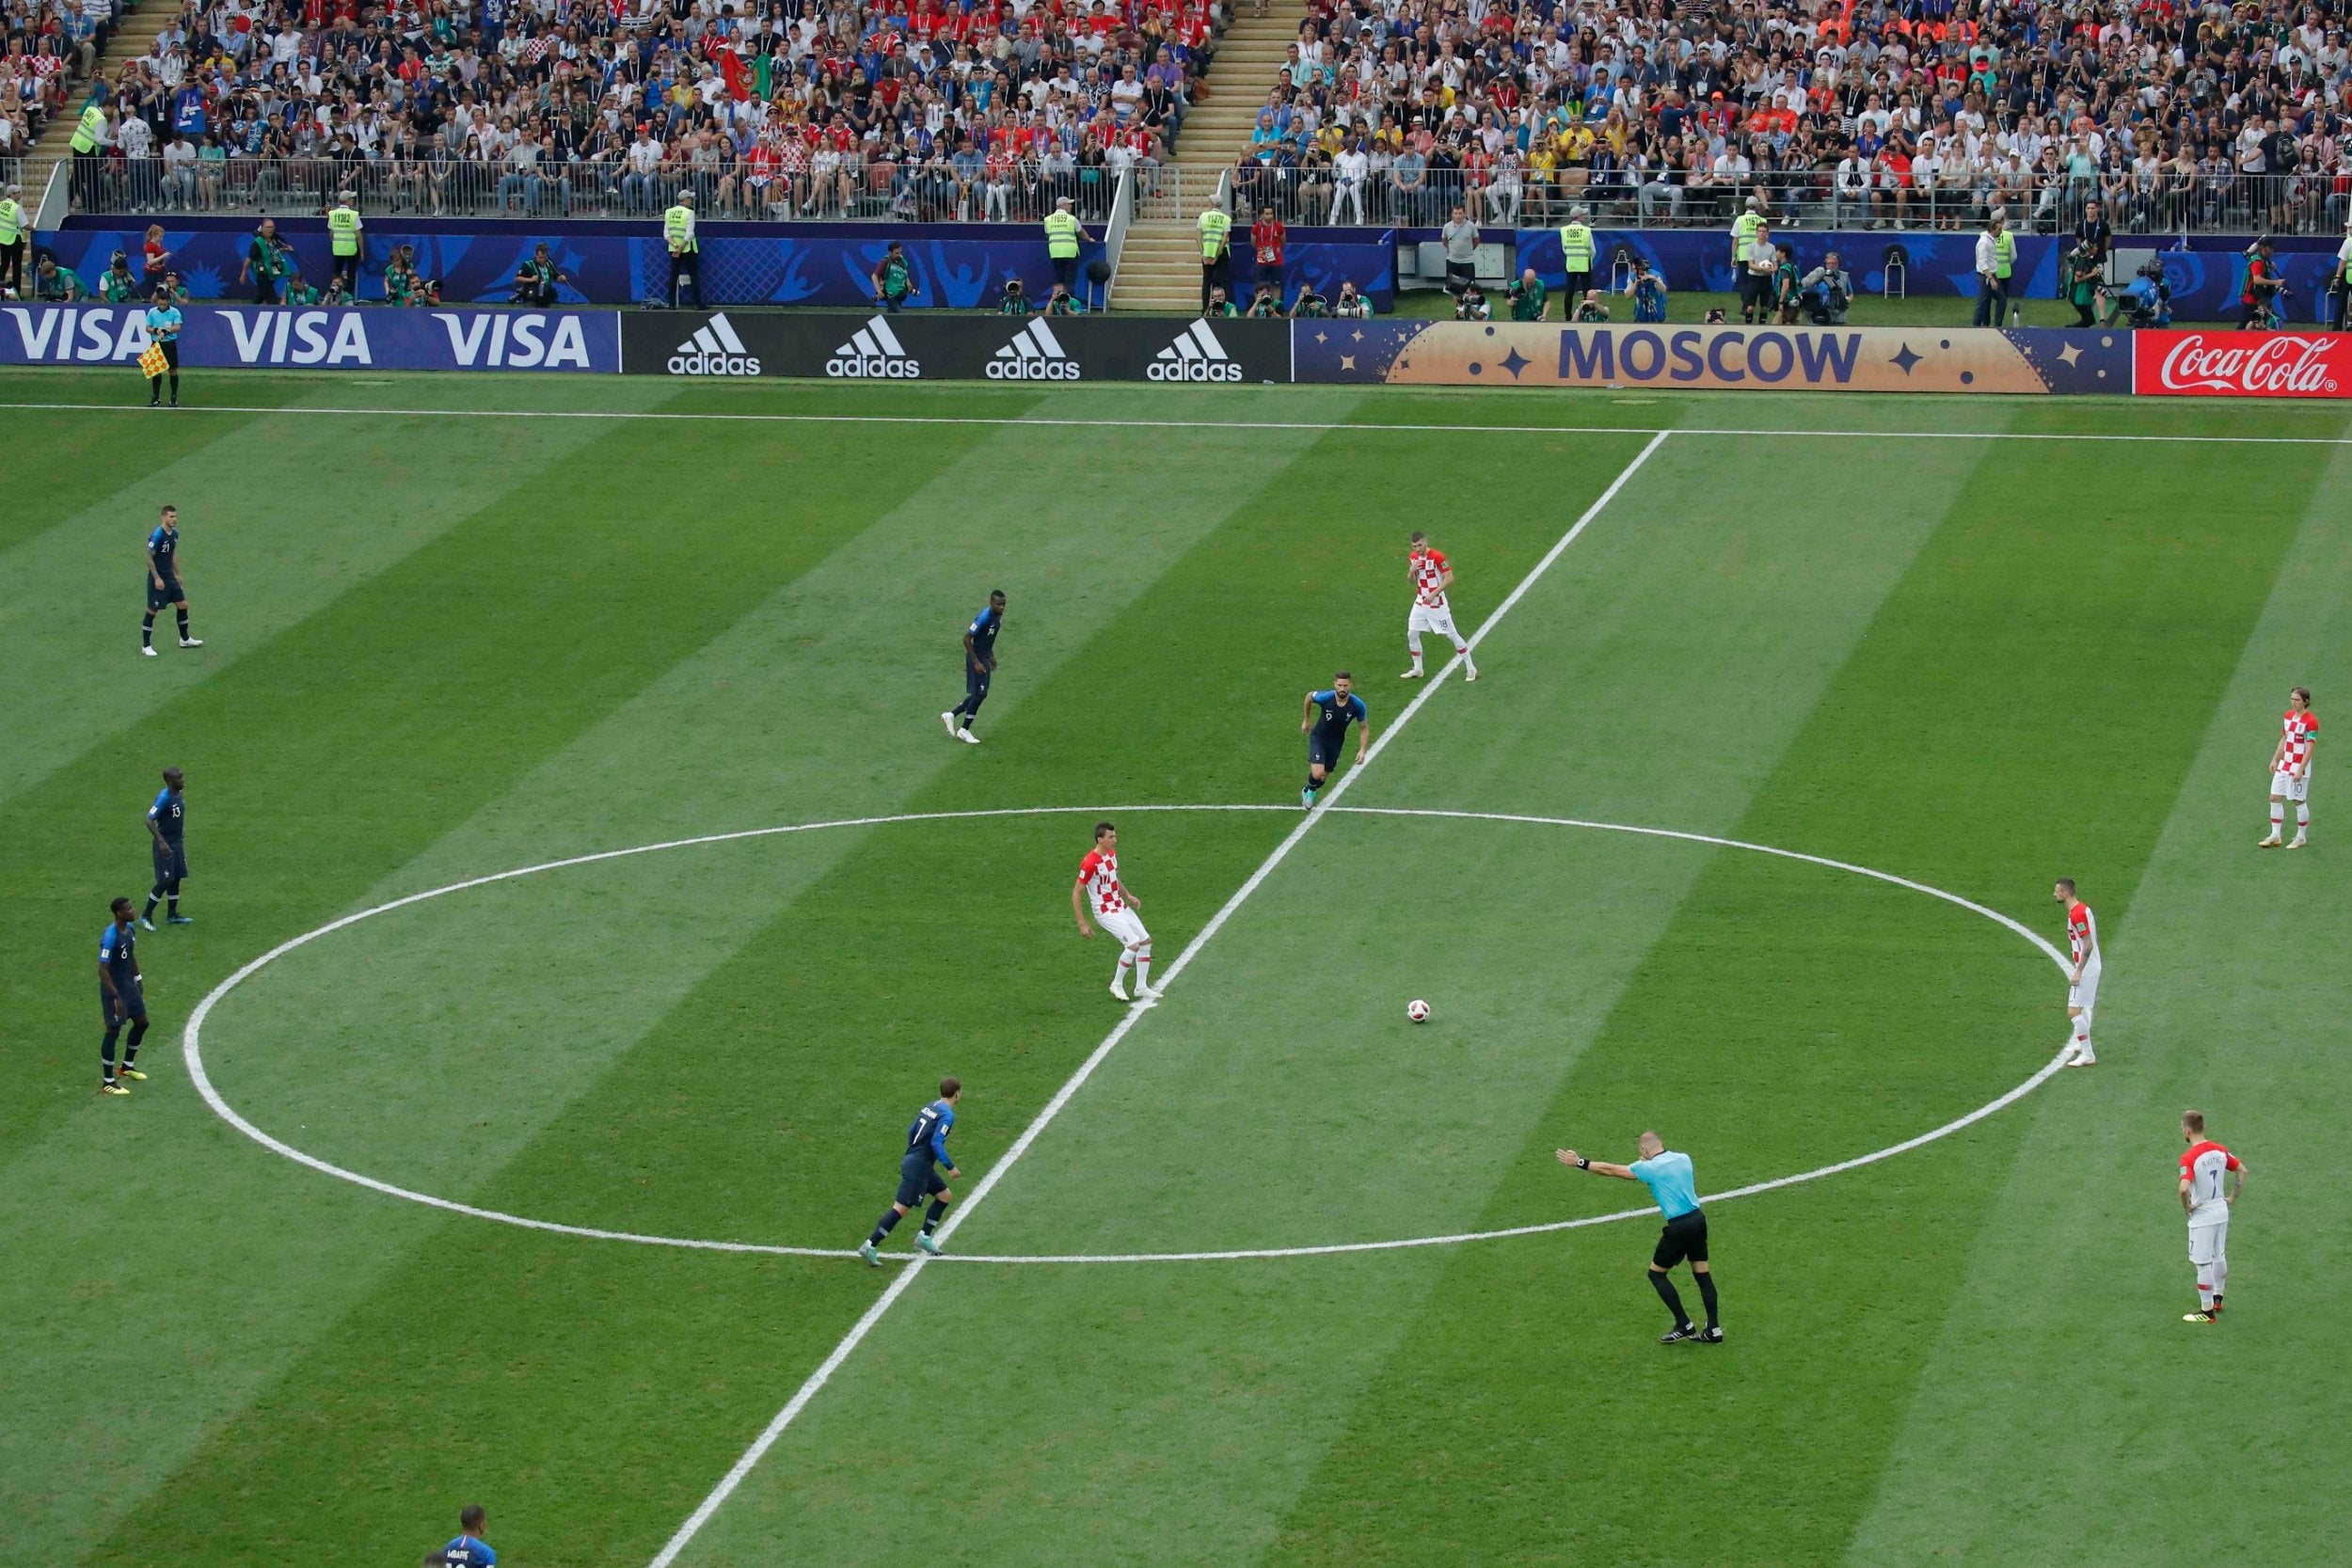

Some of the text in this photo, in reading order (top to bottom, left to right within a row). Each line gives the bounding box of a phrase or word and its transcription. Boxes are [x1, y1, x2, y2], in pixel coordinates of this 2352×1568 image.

[2, 309, 153, 360] VISA
[215, 311, 371, 363] VISA
[432, 314, 590, 367] VISA
[668, 353, 760, 374] adidas
[826, 355, 919, 377] adidas
[1559, 329, 1862, 382] MOSCOW
[2161, 335, 2340, 391] Coca-Cola
[986, 356, 1080, 379] adidas
[1147, 358, 1242, 381] adidas
[161, 543, 170, 553] 21
[1439, 619, 1449, 628] 18
[1326, 712, 1333, 721] 9
[2294, 782, 2303, 794] 10
[172, 806, 181, 818] 13
[120, 947, 128, 959] 6
[913, 1117, 927, 1145] 7
[2209, 1169, 2217, 1199] 7
